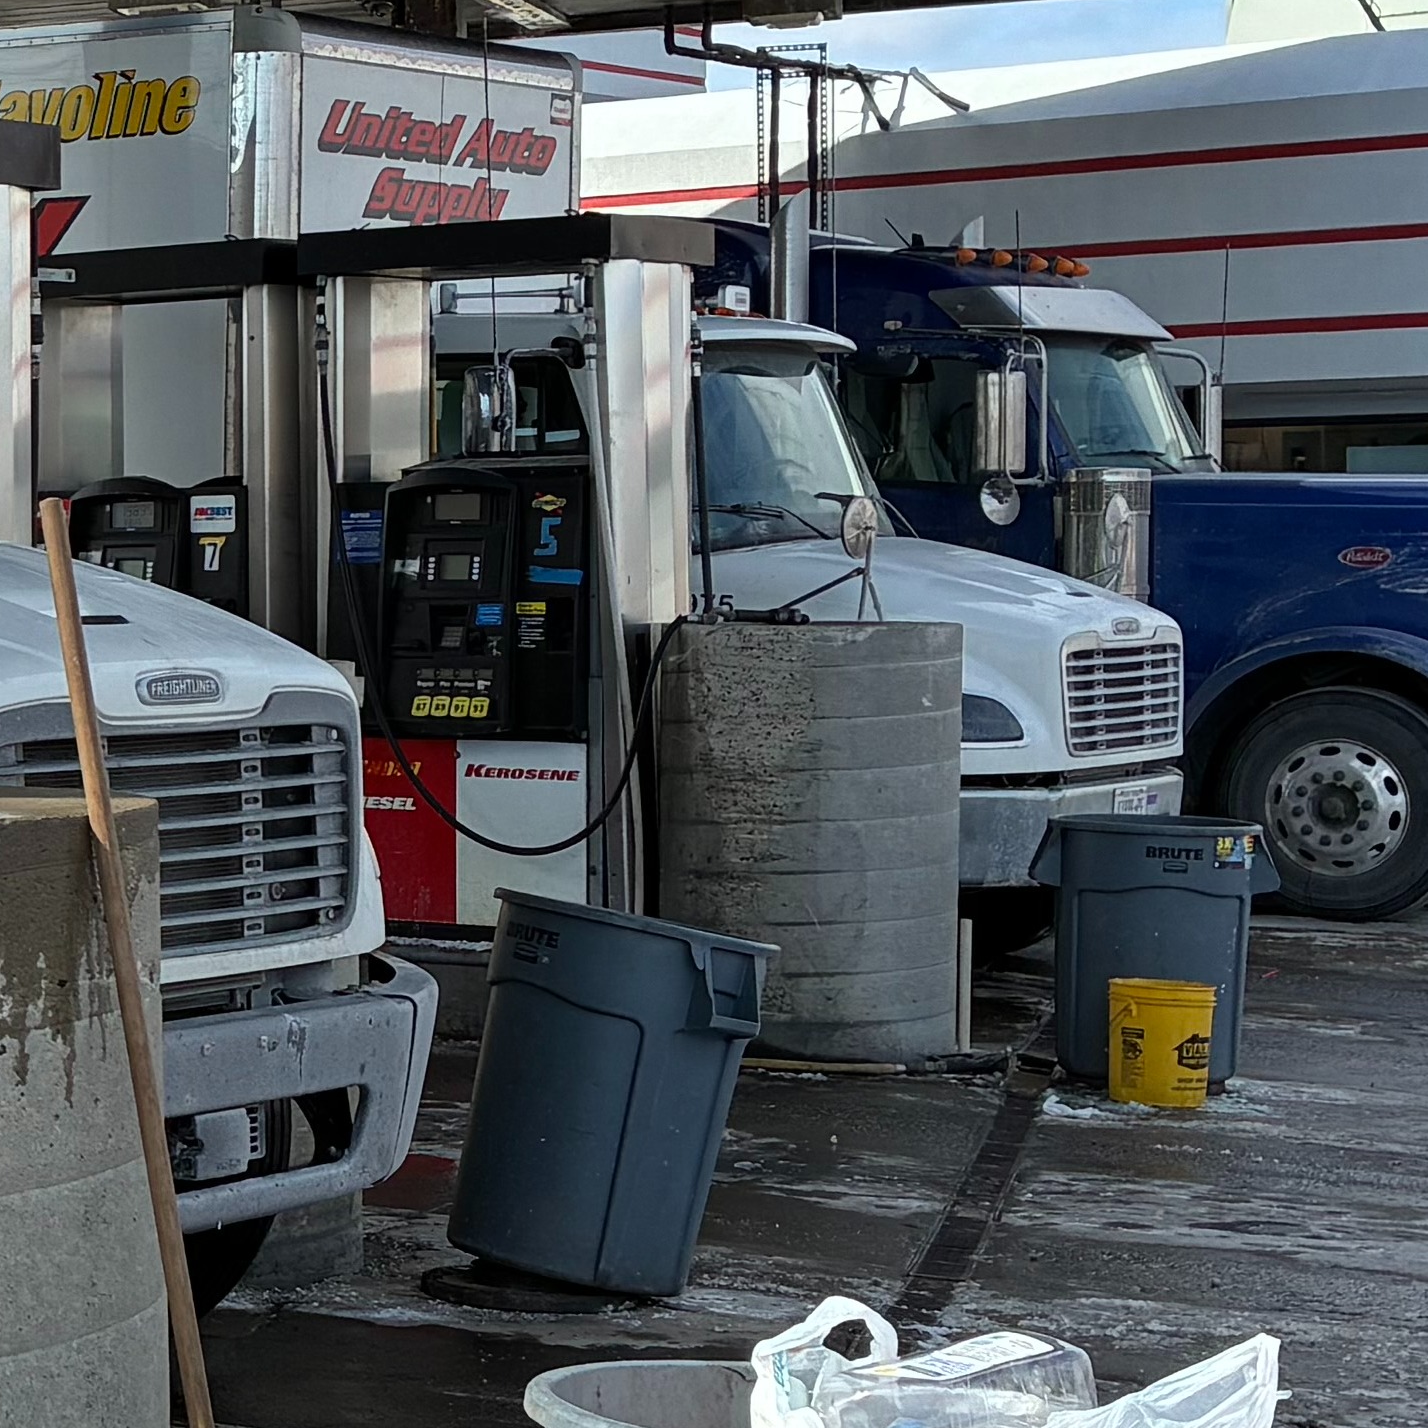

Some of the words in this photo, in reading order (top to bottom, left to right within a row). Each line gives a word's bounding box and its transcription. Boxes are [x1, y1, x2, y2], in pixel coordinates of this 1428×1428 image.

[318, 98, 467, 165] United
[455, 119, 557, 176] Auto
[363, 167, 509, 225] Supply
[199, 536, 226, 570] 7
[534, 517, 562, 556] 5
[464, 763, 580, 781] KEROSENE
[1146, 846, 1204, 861] BRUTE
